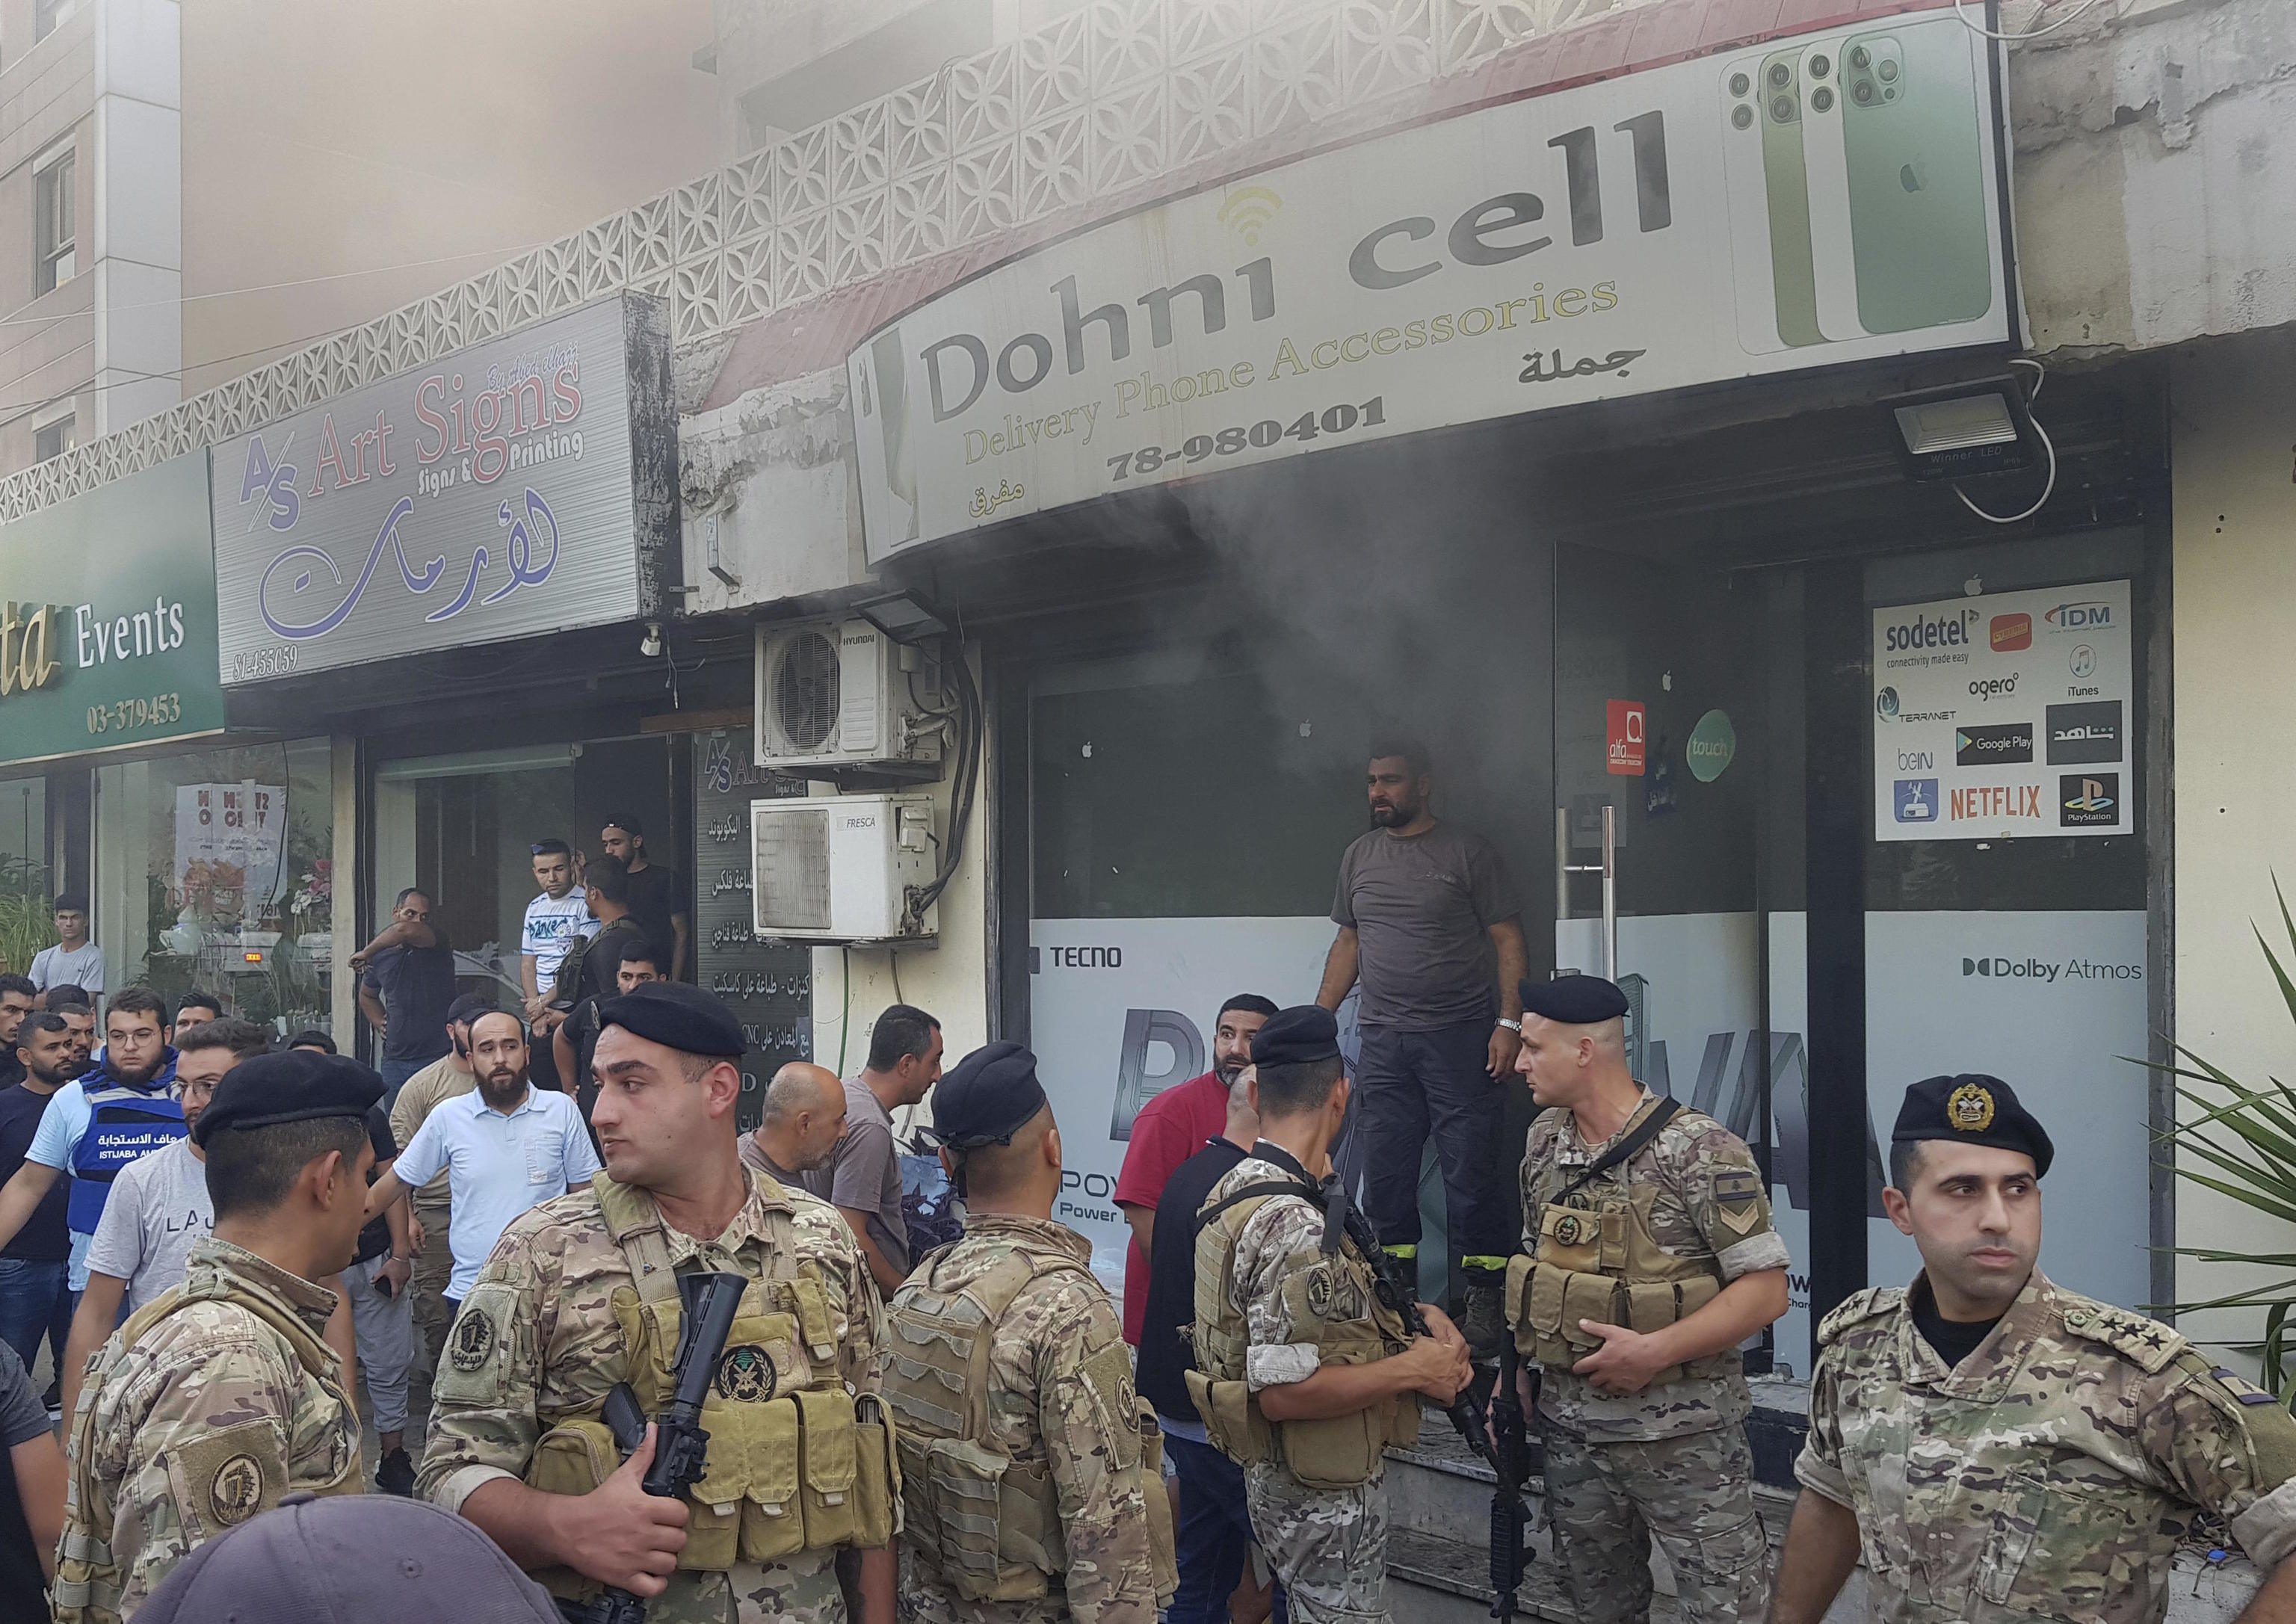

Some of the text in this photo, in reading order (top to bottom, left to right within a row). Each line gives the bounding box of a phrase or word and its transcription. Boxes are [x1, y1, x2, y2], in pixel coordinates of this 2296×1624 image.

[920, 110, 1672, 424] Dohni cell
[963, 280, 1620, 466] Delivery Phone Accessories
[1519, 347, 1647, 383] جملة
[307, 410, 397, 498] Art
[413, 362, 583, 484] Signs
[1105, 396, 1386, 482] 78-980401
[416, 430, 585, 498] Signs & Printing
[968, 478, 1025, 518] مفرق
[75, 596, 185, 669] Events
[842, 635, 875, 646] HYUNDAI
[1886, 609, 1969, 652] sodetel
[232, 643, 299, 680] 81-455059
[1886, 652, 1969, 669] connectivity made easy
[2067, 685, 2099, 697] iTunes
[87, 692, 182, 734] 03-379453
[1898, 711, 1957, 723] TERRANET
[1976, 736, 2033, 751] Google Play
[2053, 725, 2115, 741] شاهد
[1609, 738, 1627, 759] alfa
[1691, 736, 1728, 756] touch
[1950, 785, 2041, 821] NETFLIX
[846, 817, 876, 830] FRESCA
[2067, 812, 2112, 823] PlayStation
[1050, 946, 1122, 969] TECNO
[1994, 957, 2142, 983] Dolby Atmos
[756, 972, 777, 1001] طباعة
[98, 1134, 152, 1147] الاستجابة
[99, 1150, 138, 1160] ISTIJABA
[1060, 1201, 1117, 1223] Power
